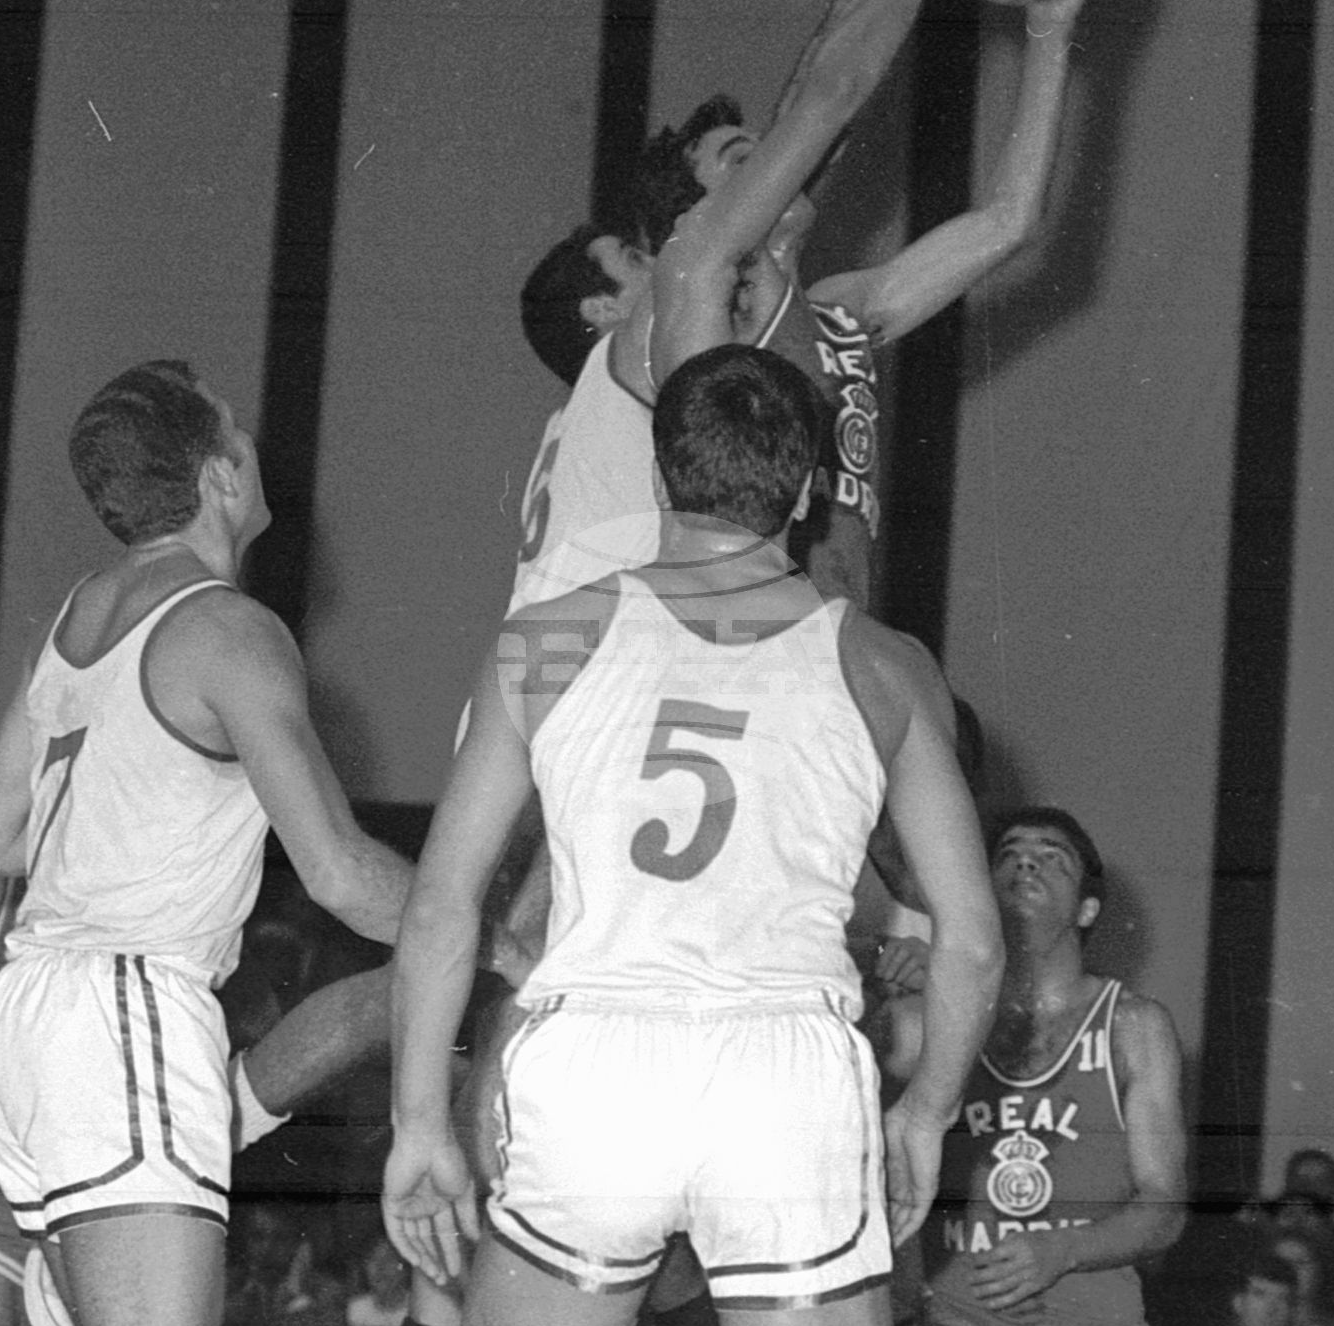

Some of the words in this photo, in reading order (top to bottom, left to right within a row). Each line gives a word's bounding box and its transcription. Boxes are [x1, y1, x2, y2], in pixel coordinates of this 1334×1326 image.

[27, 725, 89, 881] 7
[629, 697, 751, 883] 5
[965, 1095, 1080, 1141] REAL
